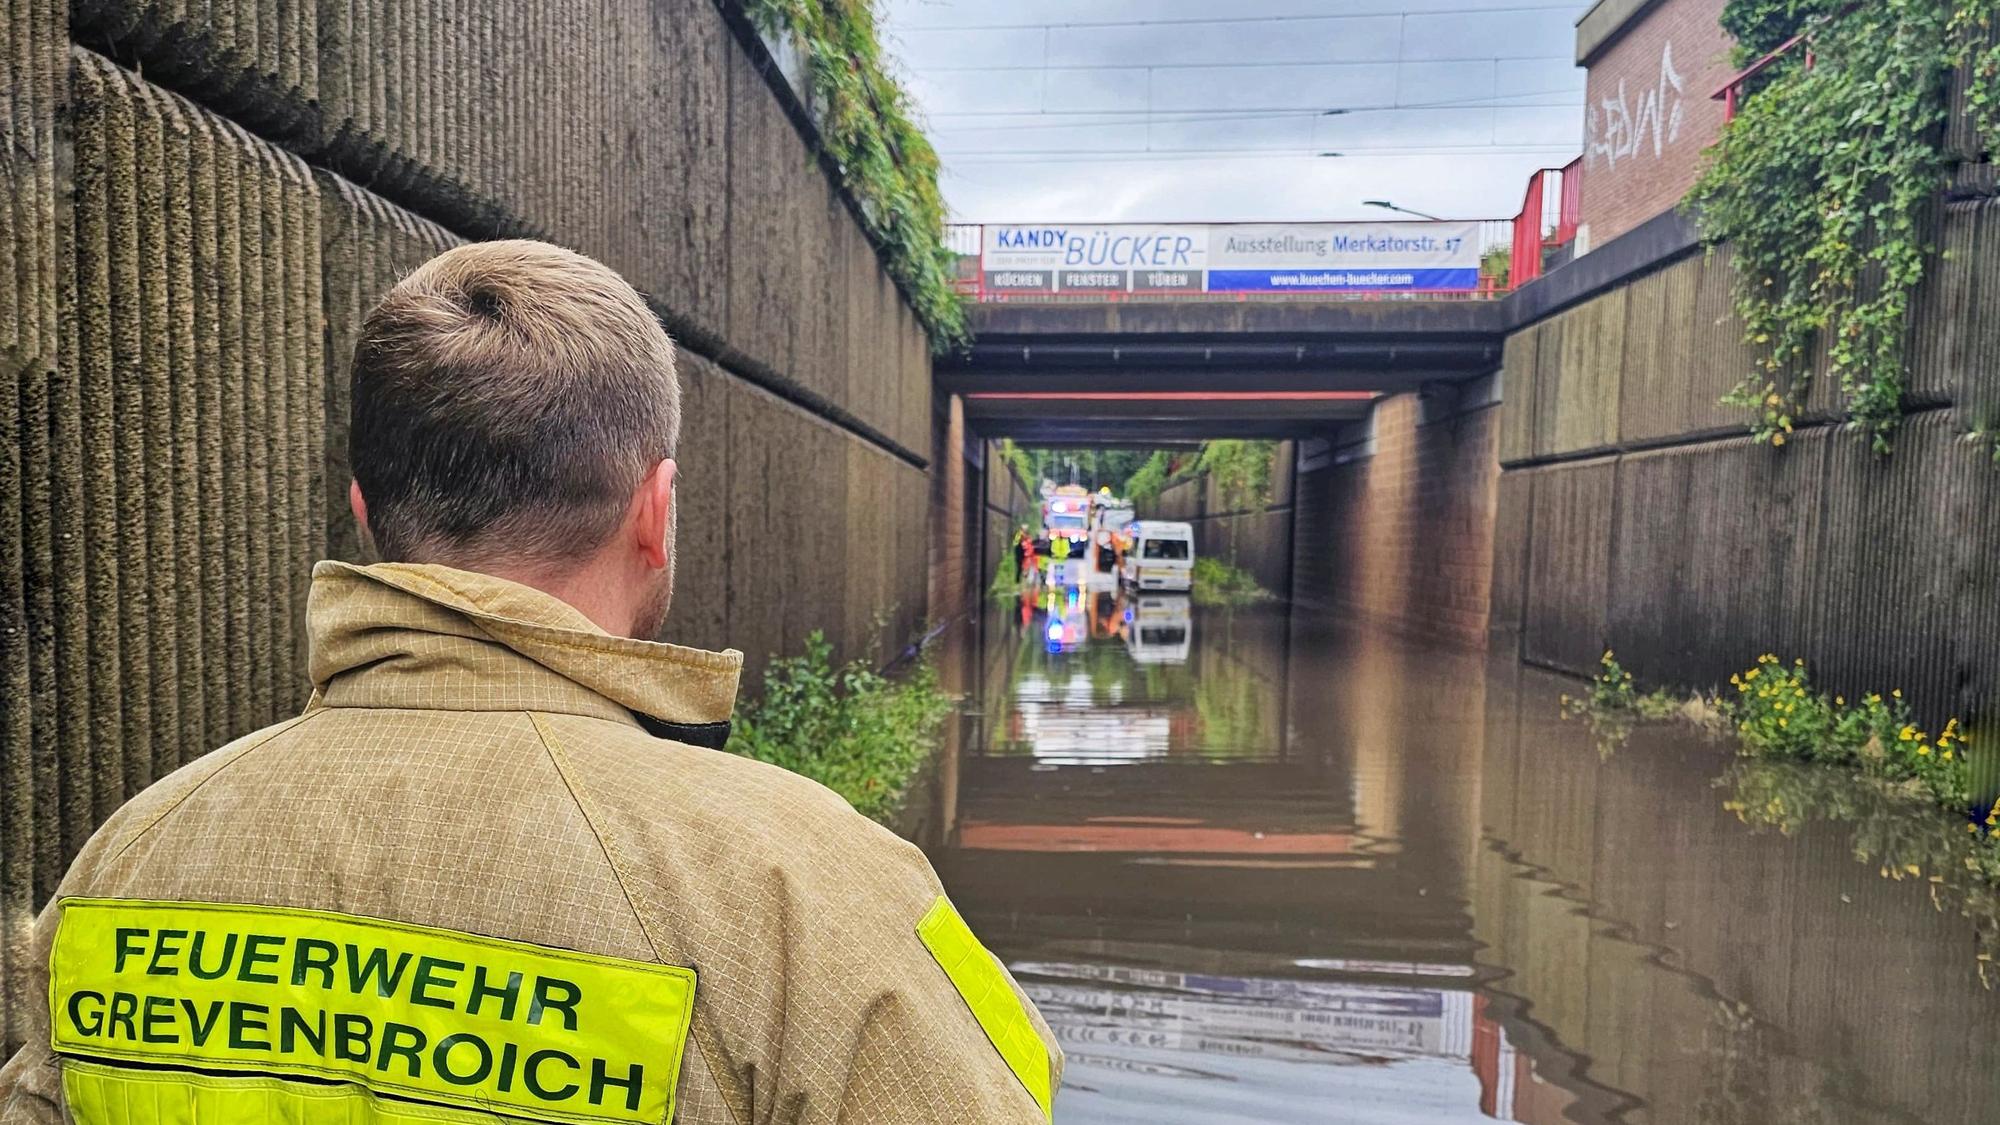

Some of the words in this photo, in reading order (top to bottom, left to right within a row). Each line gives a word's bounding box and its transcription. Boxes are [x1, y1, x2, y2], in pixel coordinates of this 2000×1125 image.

[998, 230, 1067, 248] KANDY
[1065, 231, 1192, 265] BÜCKER
[1225, 234, 1326, 256] Ausstellung
[1332, 234, 1439, 252] Merkatorstr.
[1445, 238, 1461, 254] 17
[994, 271, 1043, 286] KÜCHEN
[1066, 272, 1120, 286] FENSTER
[1148, 271, 1188, 286] TÜREN
[114, 927, 582, 1032] FEUERWEHR
[67, 989, 643, 1111] GREVENBROICH
